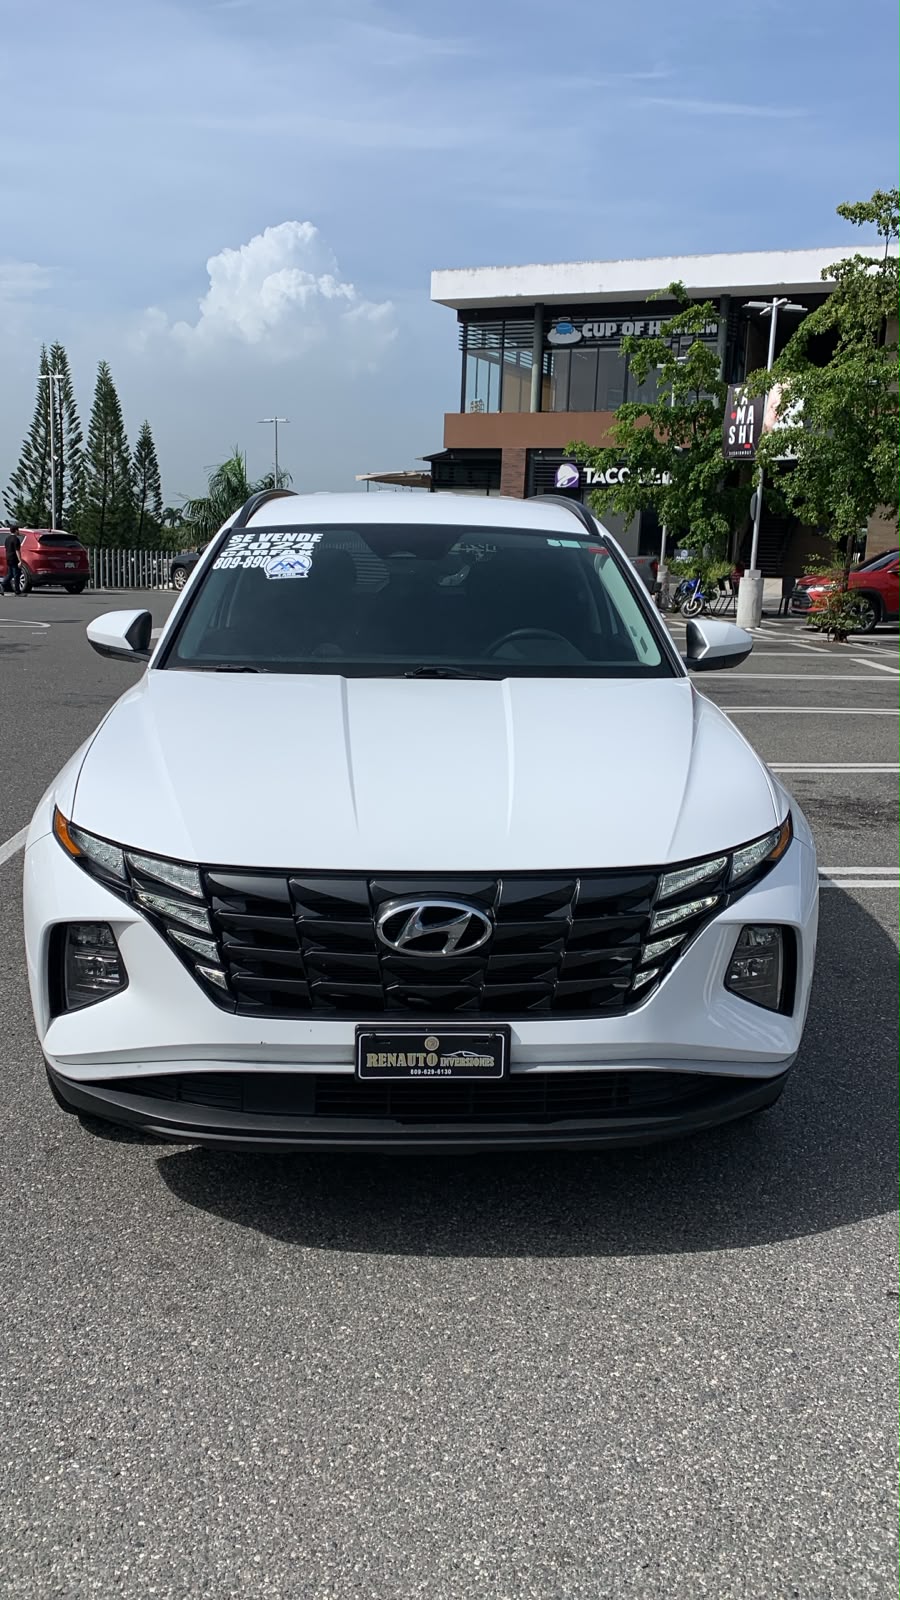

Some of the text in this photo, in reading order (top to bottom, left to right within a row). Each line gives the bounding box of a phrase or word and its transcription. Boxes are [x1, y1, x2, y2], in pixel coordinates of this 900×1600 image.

[582, 322, 617, 337] CUP
[622, 321, 645, 336] OF
[736, 405, 754, 425] MA
[728, 425, 754, 445] SHI
[229, 533, 324, 543] SE VENDE
[225, 542, 315, 551] 2024
[366, 1052, 495, 1067] RENAUTO INVERSIONES
